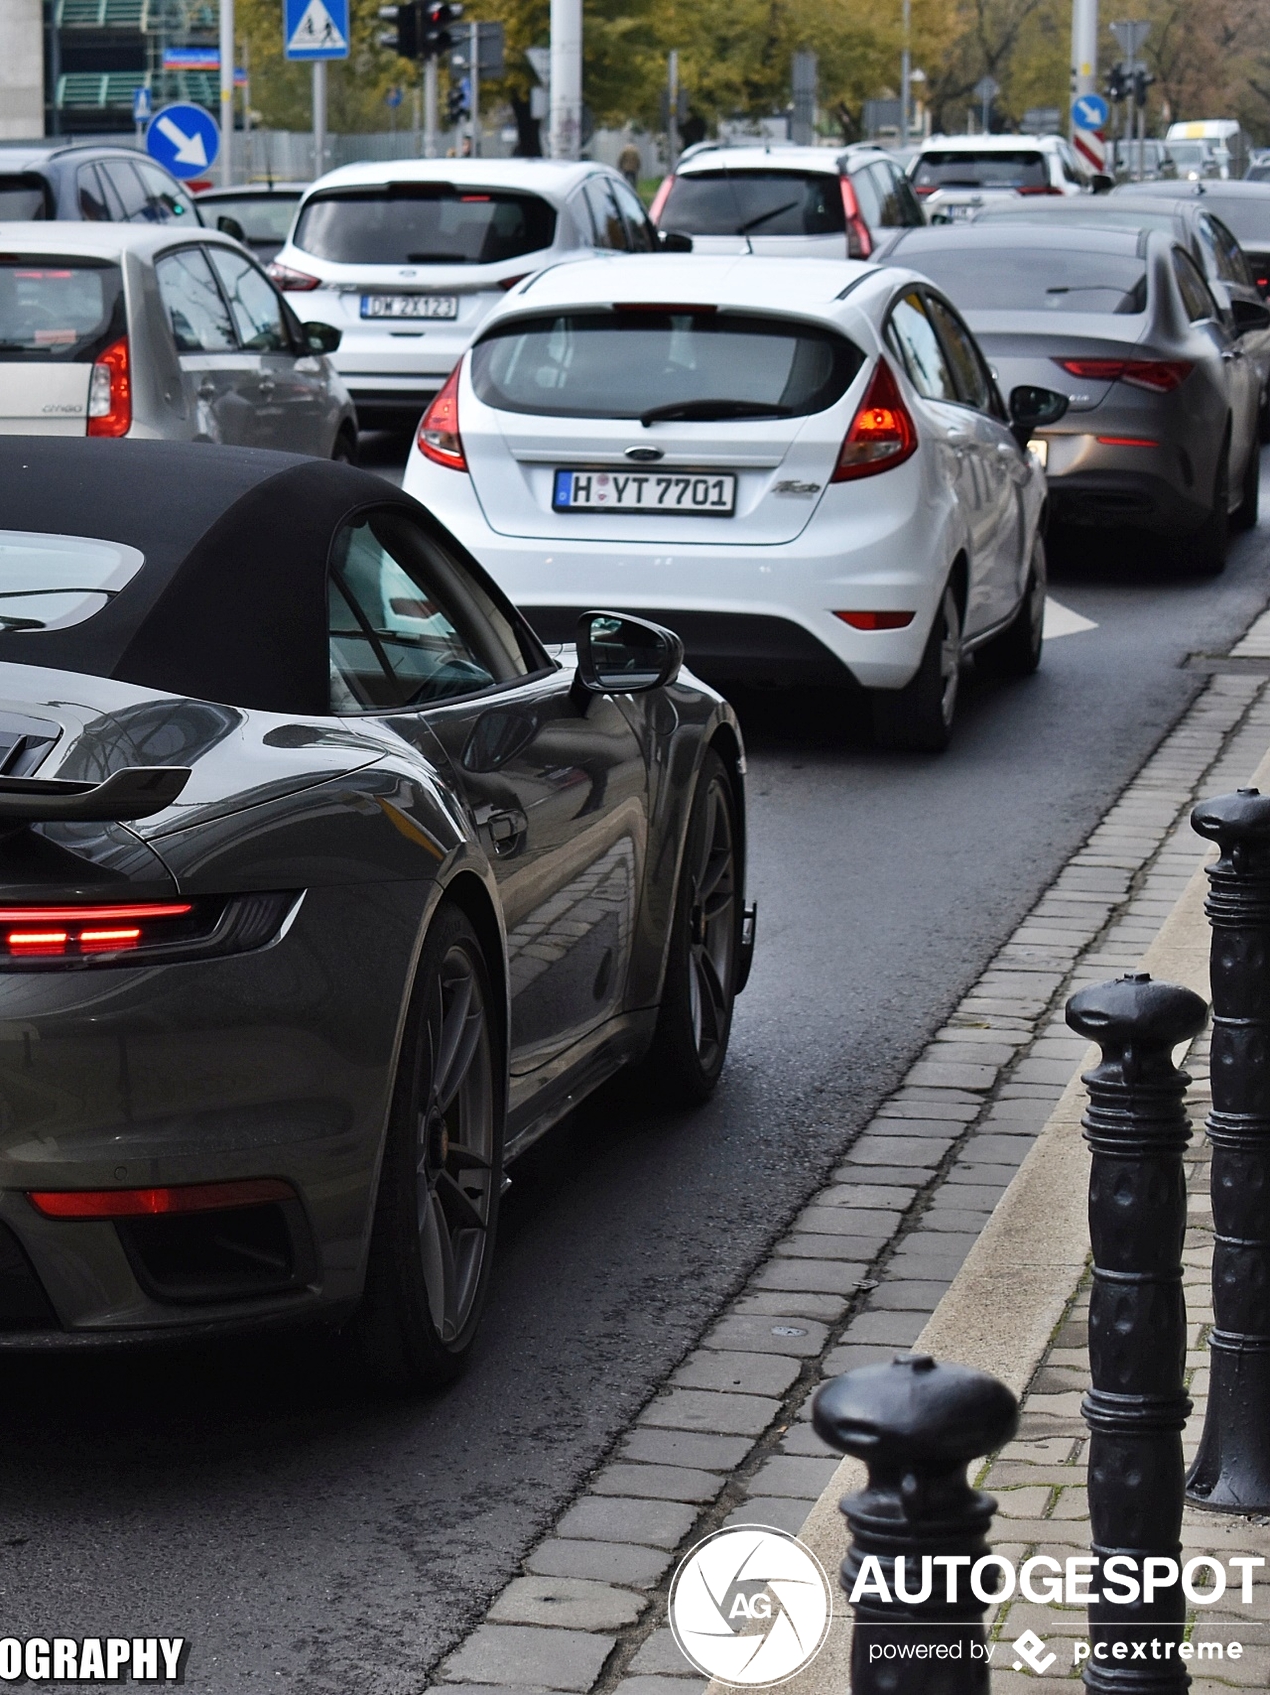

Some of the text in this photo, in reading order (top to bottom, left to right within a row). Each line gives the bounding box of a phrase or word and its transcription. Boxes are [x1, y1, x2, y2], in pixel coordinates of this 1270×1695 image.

[573, 475, 728, 507] H YT 7701
